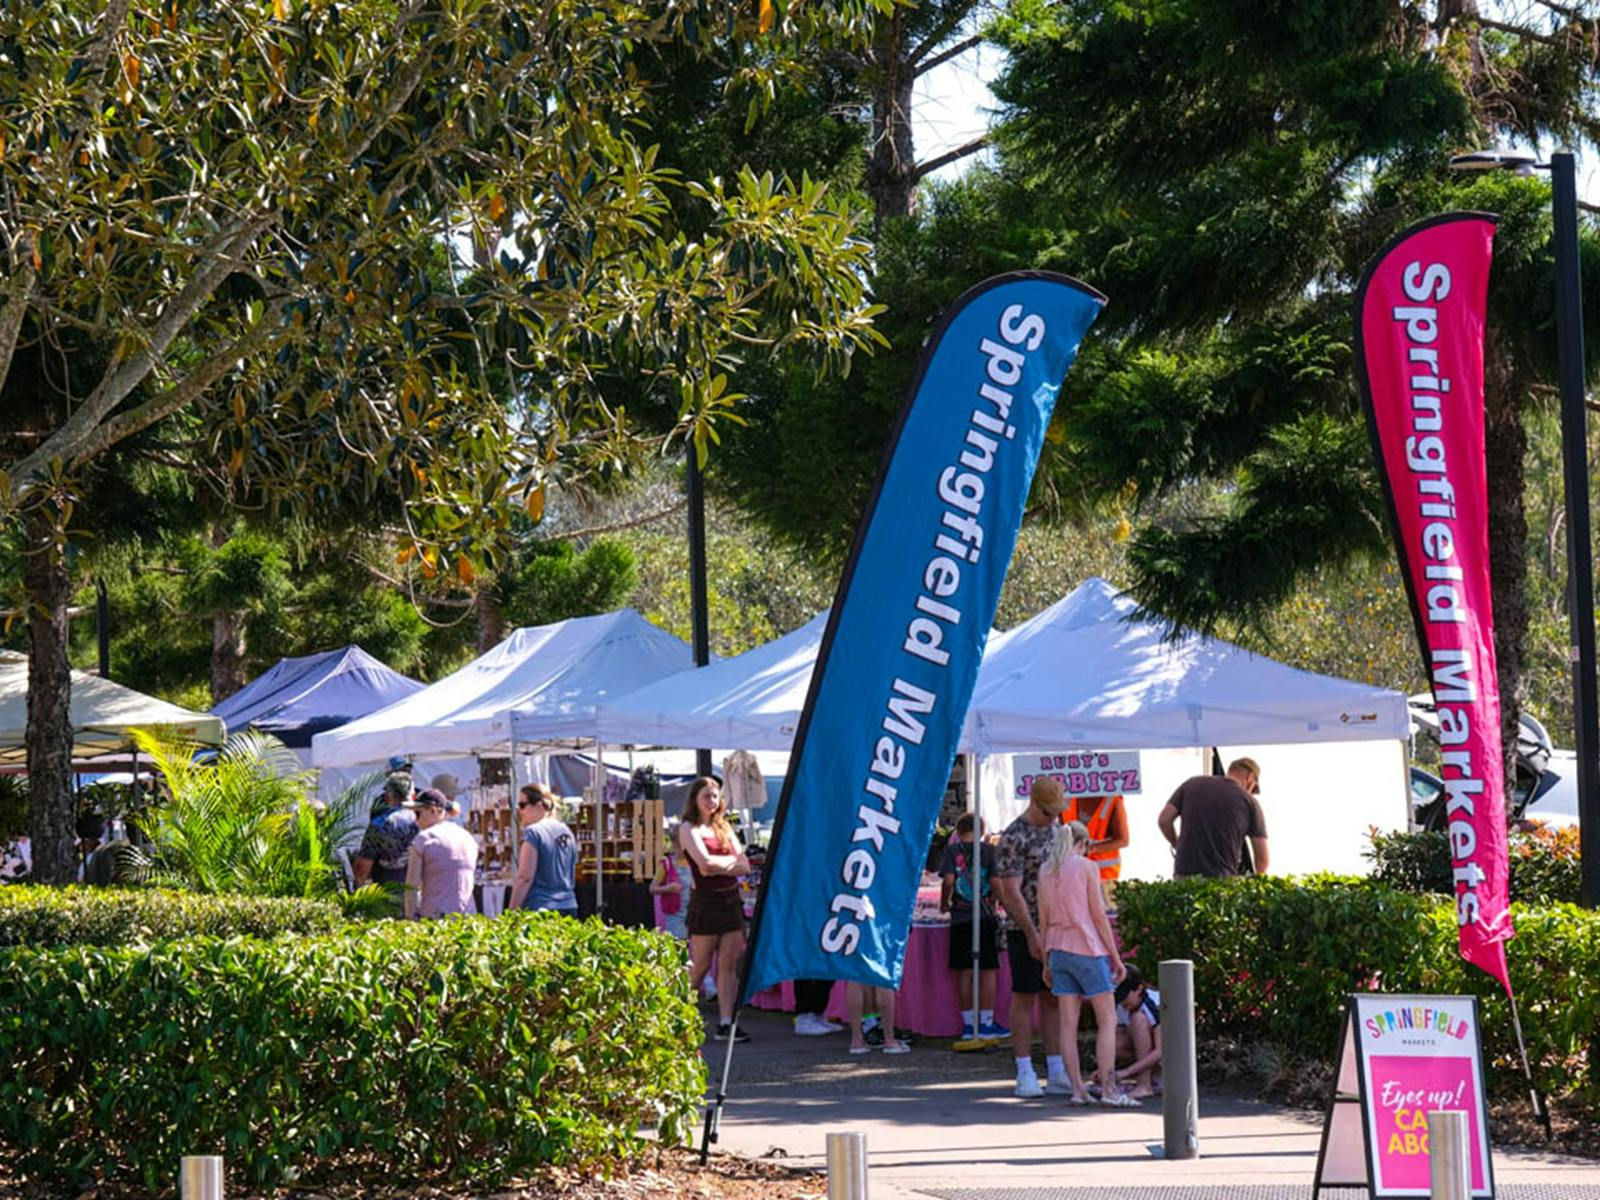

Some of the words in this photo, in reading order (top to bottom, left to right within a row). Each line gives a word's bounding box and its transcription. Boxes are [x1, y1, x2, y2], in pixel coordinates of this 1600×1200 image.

[904, 303, 1046, 666] Springfield
[1393, 260, 1466, 624] Springfield
[1431, 648, 1486, 927] Markets
[1040, 753, 1109, 770] RUBY'S
[1016, 769, 1141, 796] JBBITZ
[820, 678, 936, 956] Markets
[1381, 1080, 1425, 1114] Eyes
[1427, 1079, 1466, 1112] up!
[1394, 1109, 1428, 1131] CA
